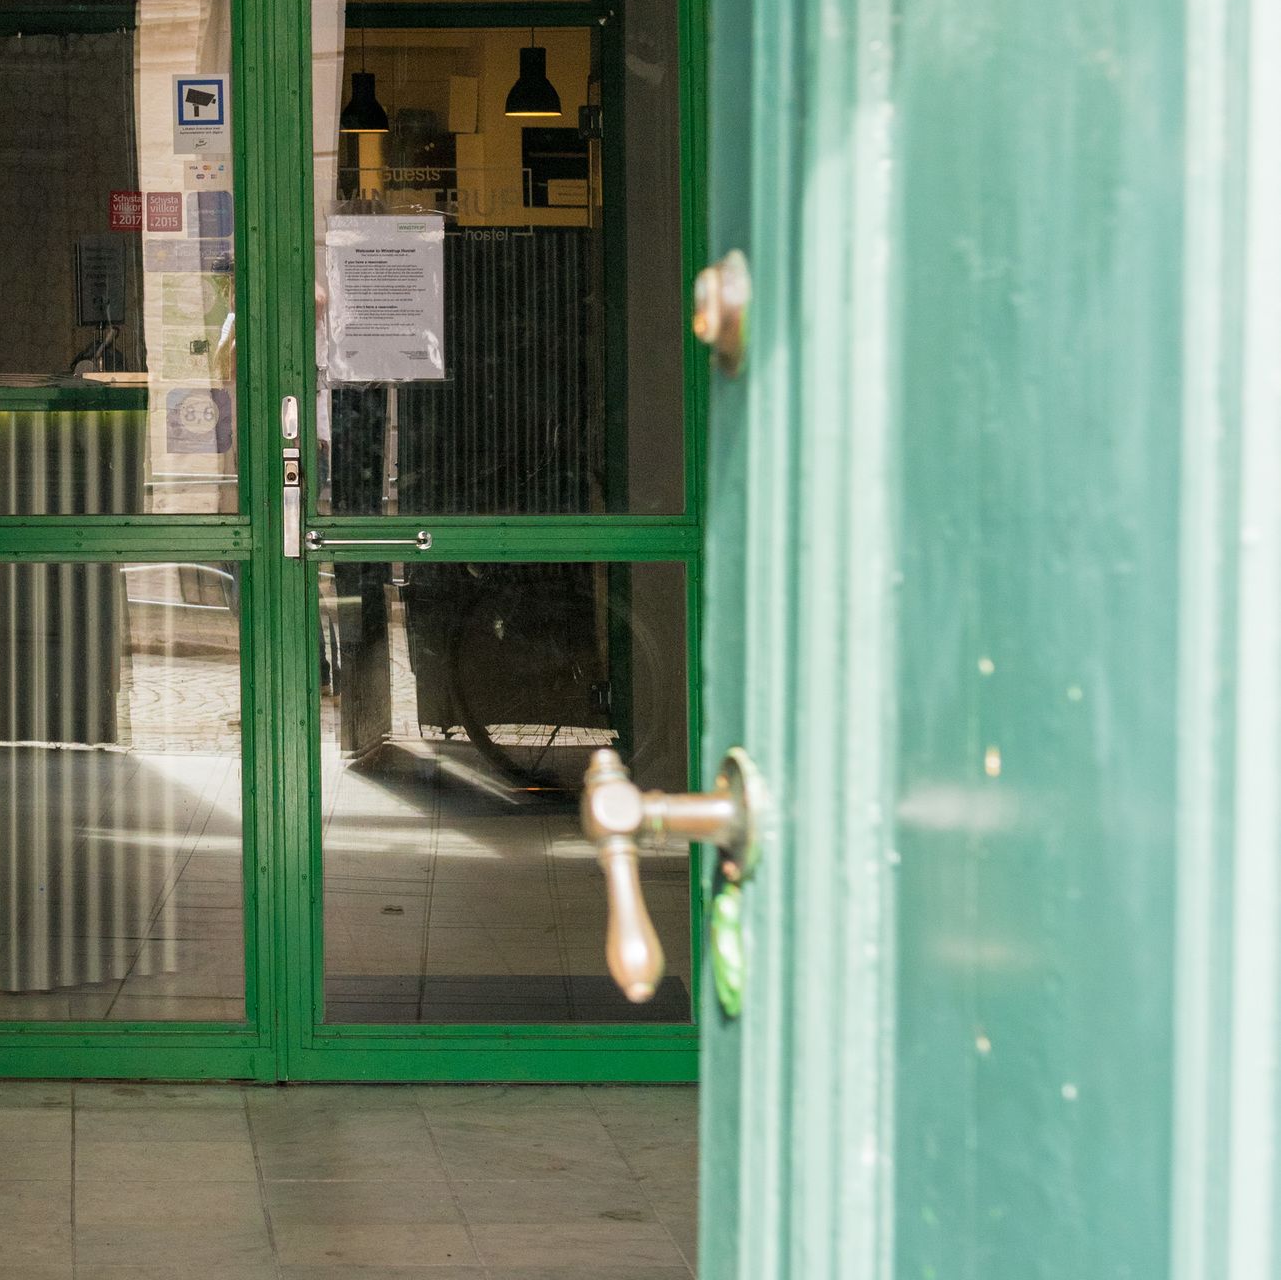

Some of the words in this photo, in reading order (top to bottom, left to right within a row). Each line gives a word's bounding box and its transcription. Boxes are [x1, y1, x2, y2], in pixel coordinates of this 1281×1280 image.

[112, 194, 142, 204] Schysta
[149, 195, 179, 206] Schysta
[112, 203, 142, 213] villkor
[149, 204, 179, 213] villkor
[119, 215, 142, 225] 2017
[155, 217, 178, 228] 2015
[465, 228, 509, 241] hostel
